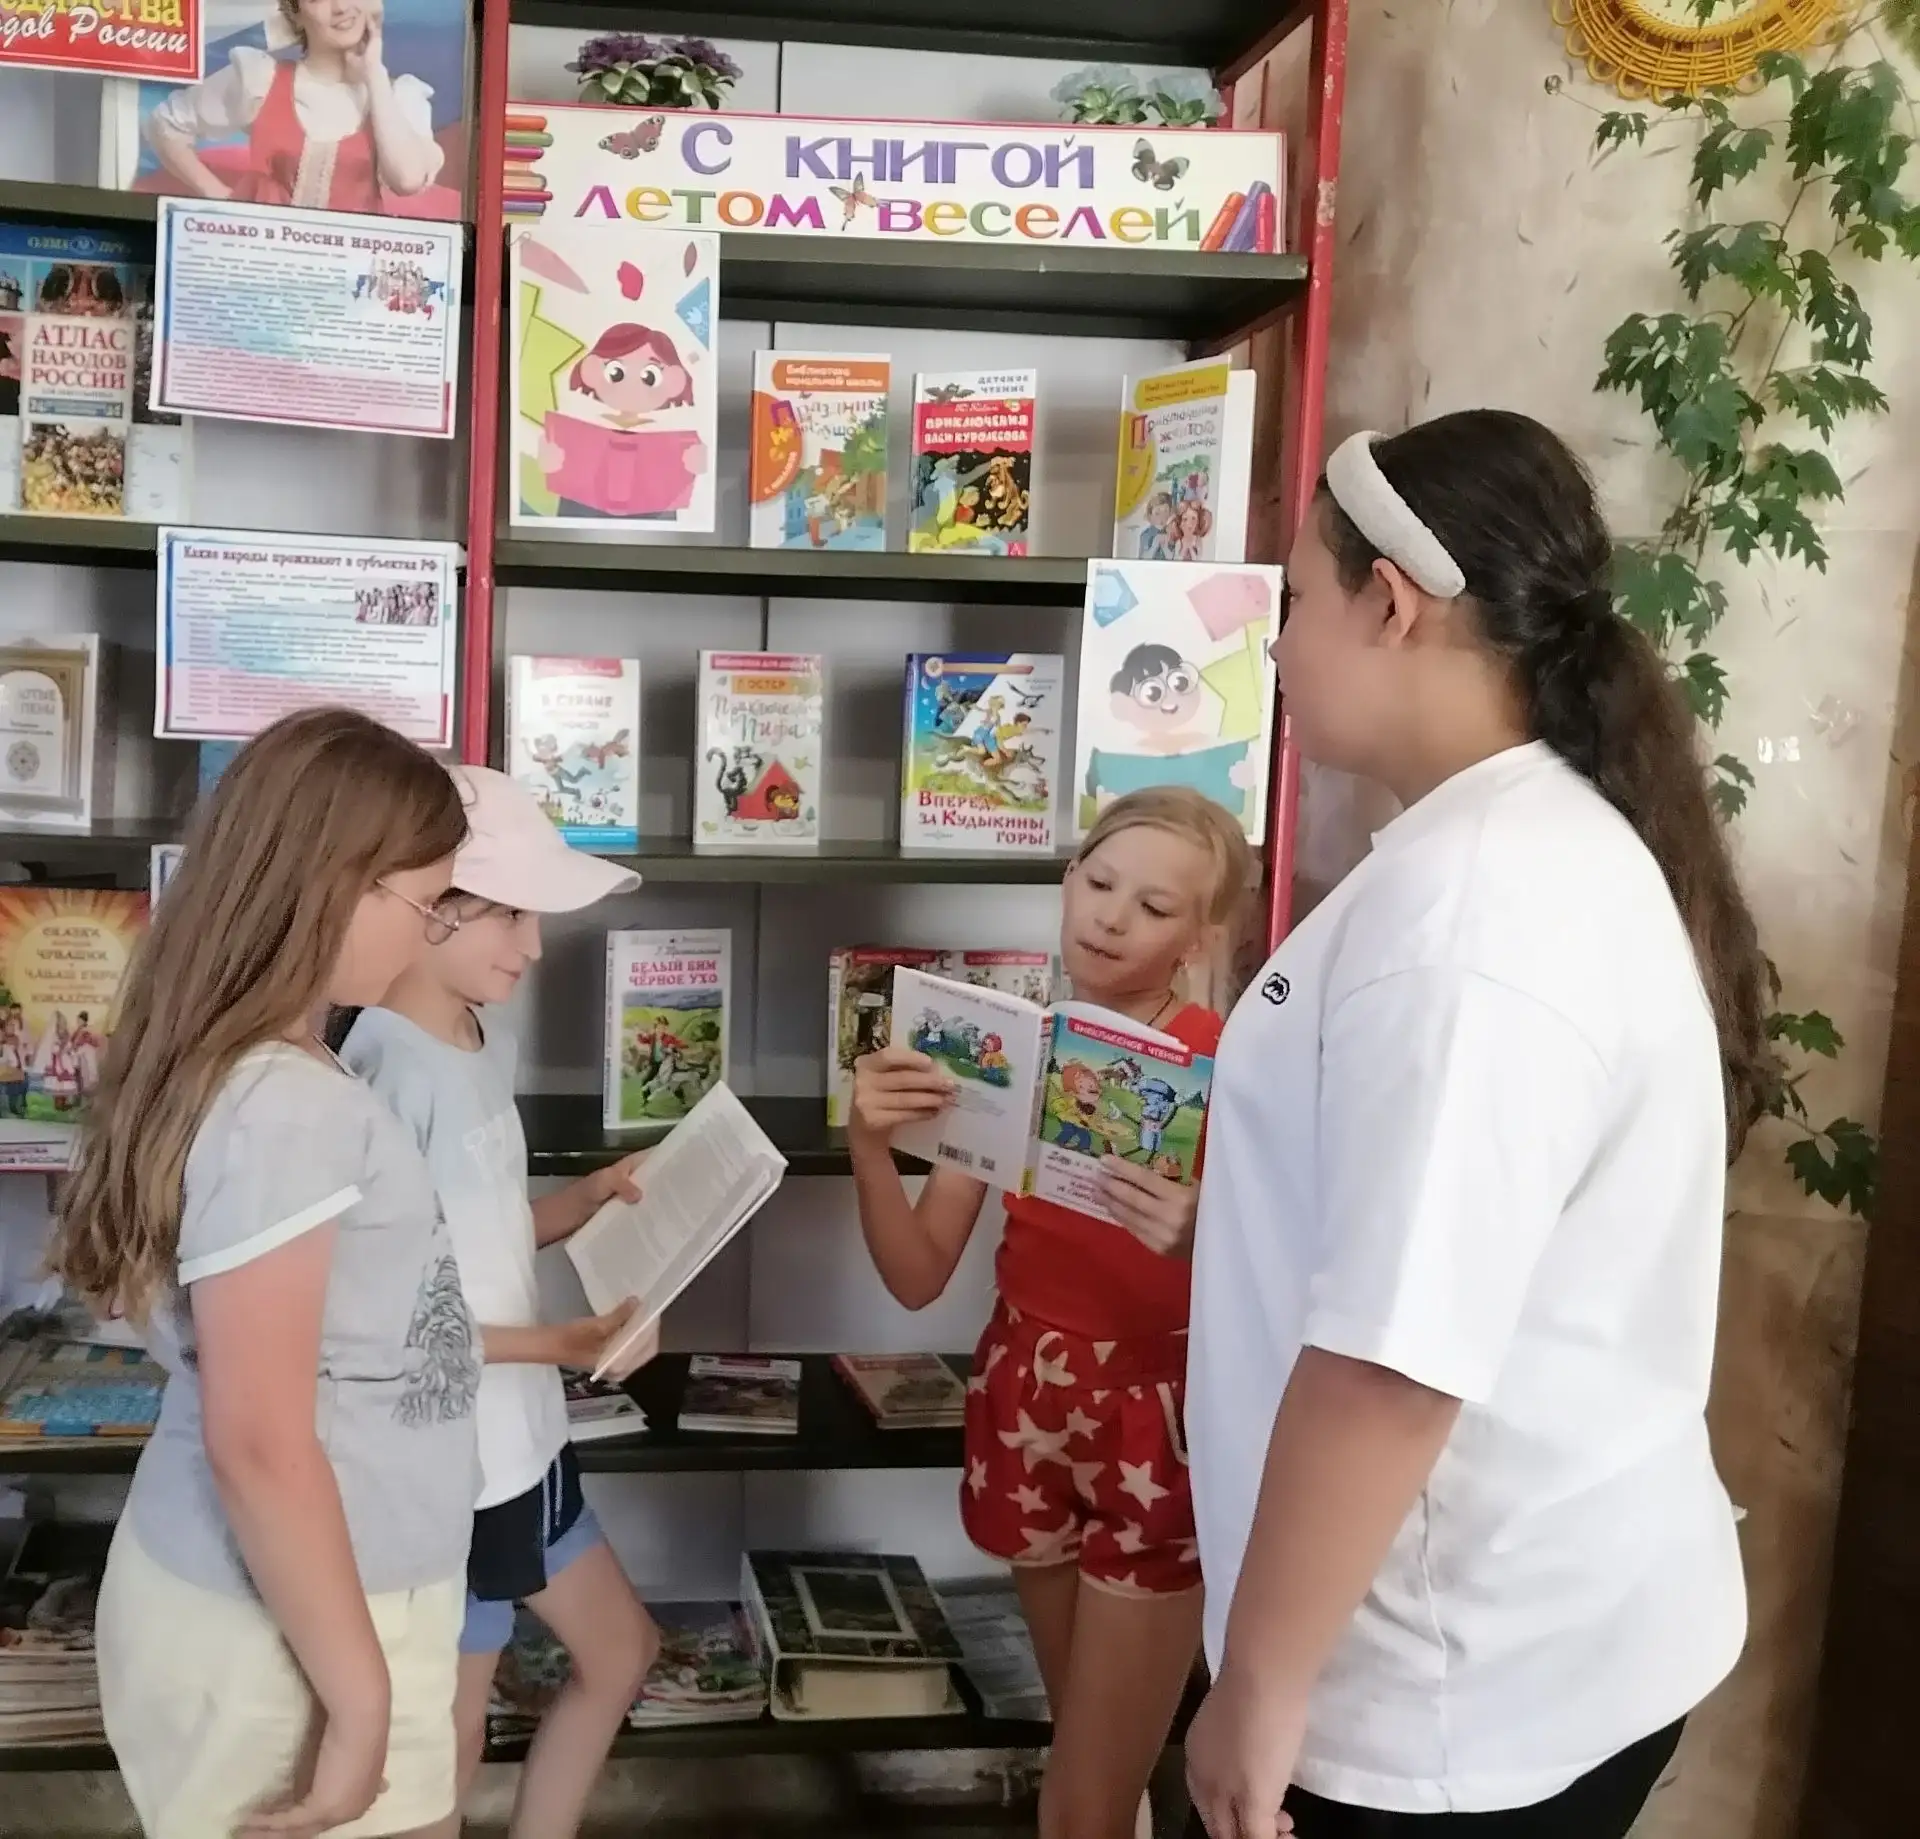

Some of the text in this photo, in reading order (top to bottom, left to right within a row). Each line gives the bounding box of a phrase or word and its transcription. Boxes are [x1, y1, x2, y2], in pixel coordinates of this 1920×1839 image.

[0, 5, 189, 53] дов России
[681, 121, 733, 175] С
[184, 217, 435, 256] Сколько в России народов?
[32, 323, 128, 350] АТЛАС
[32, 348, 128, 369] НАРОДОВ
[31, 367, 126, 389] РОССИИ
[925, 414, 1029, 429] ПРИКЛЮЧЕНИЯ
[955, 430, 1027, 443] КУРОЛЕСОВА
[183, 545, 218, 560] Какие
[222, 549, 268, 565] народы
[631, 959, 717, 973] БЕЛЫЙ БИМ
[690, 973, 718, 985] УХО
[1073, 1023, 1185, 1065] ВНЕКЛАССНОЕ ЧТЕНИЕ
